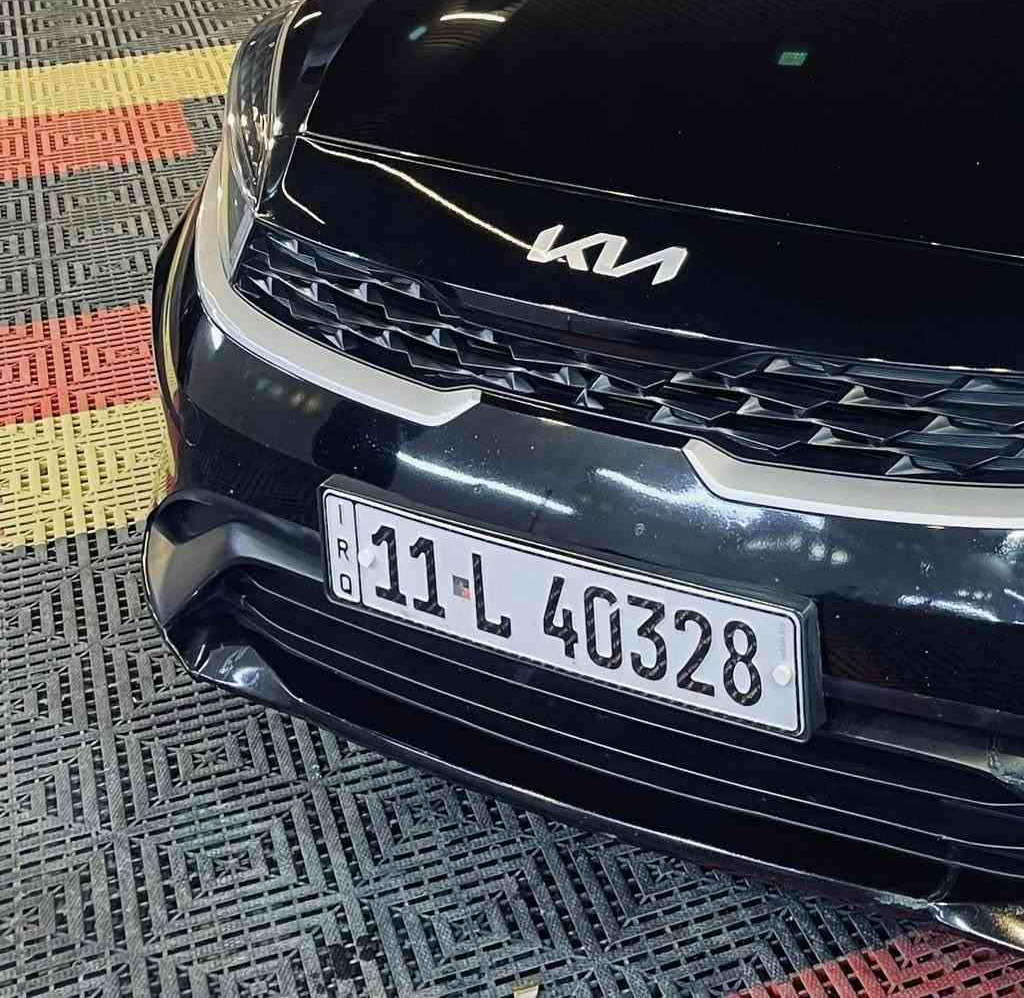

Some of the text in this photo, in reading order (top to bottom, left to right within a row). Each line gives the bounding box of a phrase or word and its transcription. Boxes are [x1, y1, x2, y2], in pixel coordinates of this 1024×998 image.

[526, 224, 689, 286] KIA
[371, 525, 446, 619] 11
[471, 552, 512, 639] L
[543, 576, 763, 707] 40328
